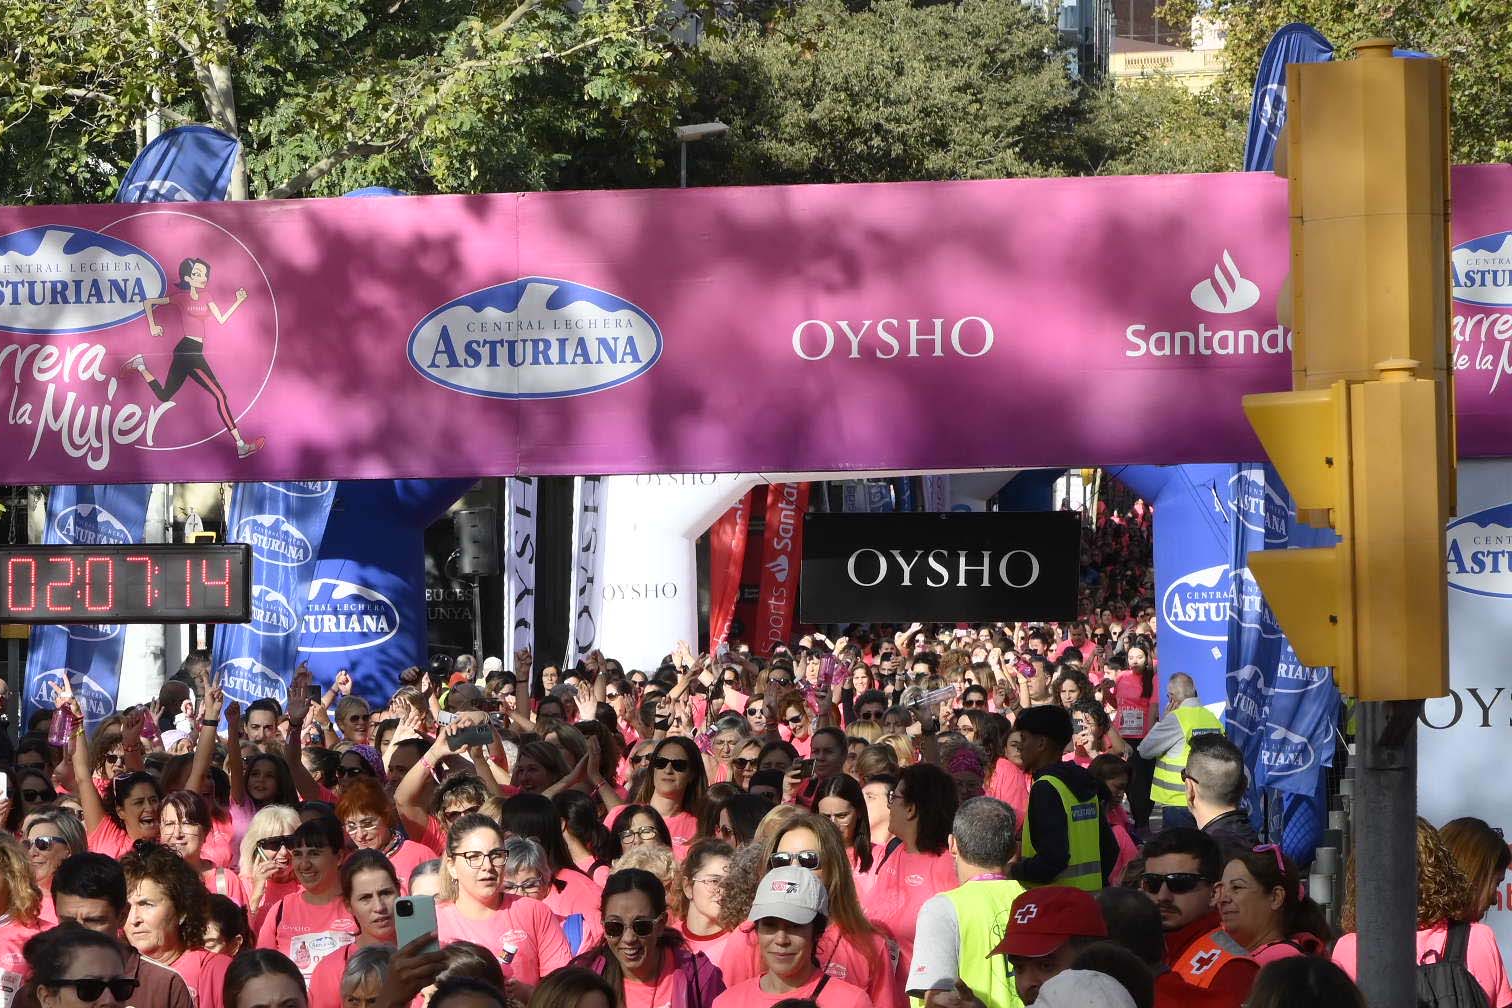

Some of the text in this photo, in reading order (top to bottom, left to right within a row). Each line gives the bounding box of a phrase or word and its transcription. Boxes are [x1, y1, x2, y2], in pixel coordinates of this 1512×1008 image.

[70, 261, 142, 272] LECHERA
[1466, 257, 1512, 266] CENTRA
[466, 318, 635, 333] CENTRAL LECHERA
[791, 315, 995, 362] OYSHO
[427, 324, 642, 370] ASTURIANA
[1475, 342, 1494, 370] la
[8, 384, 33, 426] la
[26, 376, 177, 471] Mujer
[847, 548, 1040, 589] OYSHO
[7, 556, 231, 612] 02:07:14
[601, 582, 678, 601] OYSHO
[300, 614, 390, 634] TURIANA
